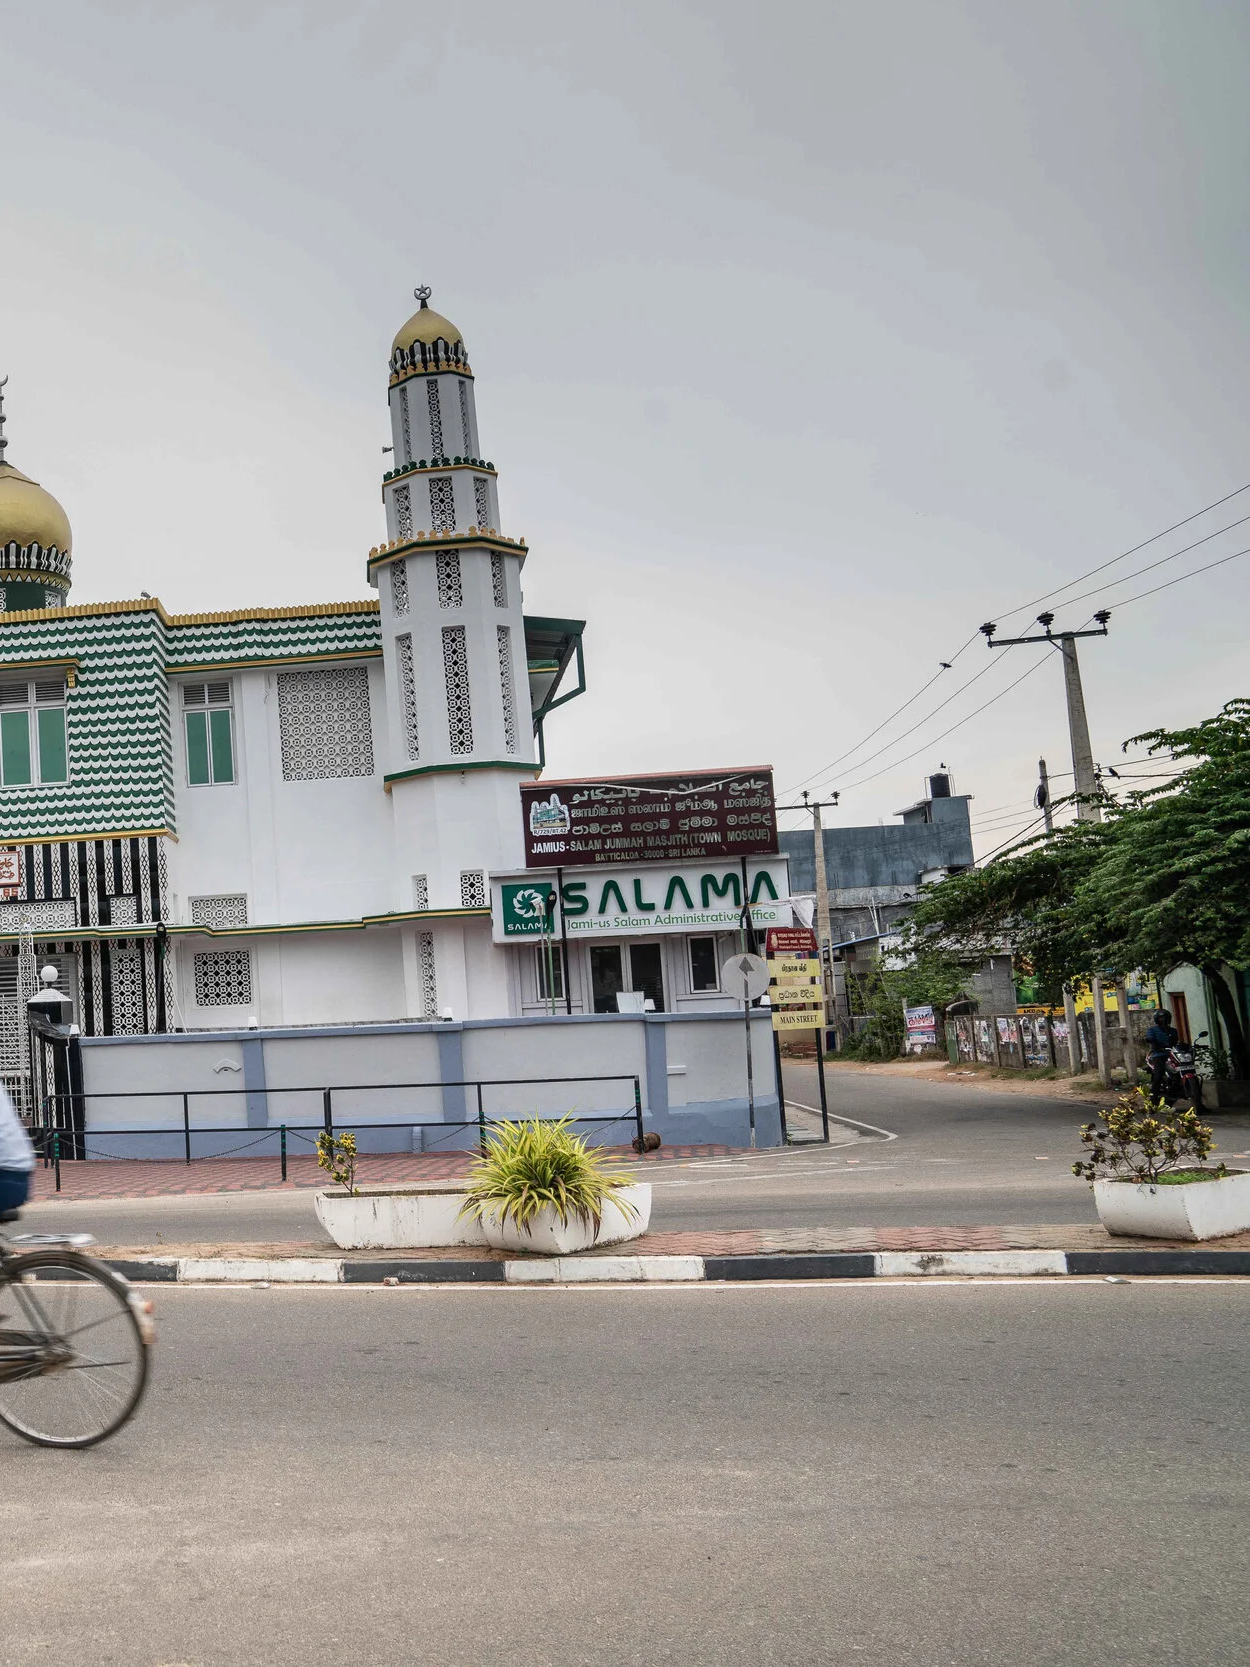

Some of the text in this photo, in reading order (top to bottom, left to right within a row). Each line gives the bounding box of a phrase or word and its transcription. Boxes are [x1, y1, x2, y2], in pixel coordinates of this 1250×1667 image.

[729, 778, 769, 795] جامع
[604, 837, 644, 850] JUMMAH
[646, 833, 688, 847] MASJITH
[727, 829, 770, 842] MOSQUE)
[595, 851, 639, 861] BATTICALOA
[669, 848, 680, 857] SRI
[682, 847, 706, 856] LANKA
[561, 870, 779, 915] SALAMA
[567, 909, 776, 930] Jami-us Salam Administrative ffice
[780, 1014, 818, 1024] MAIN STREET
